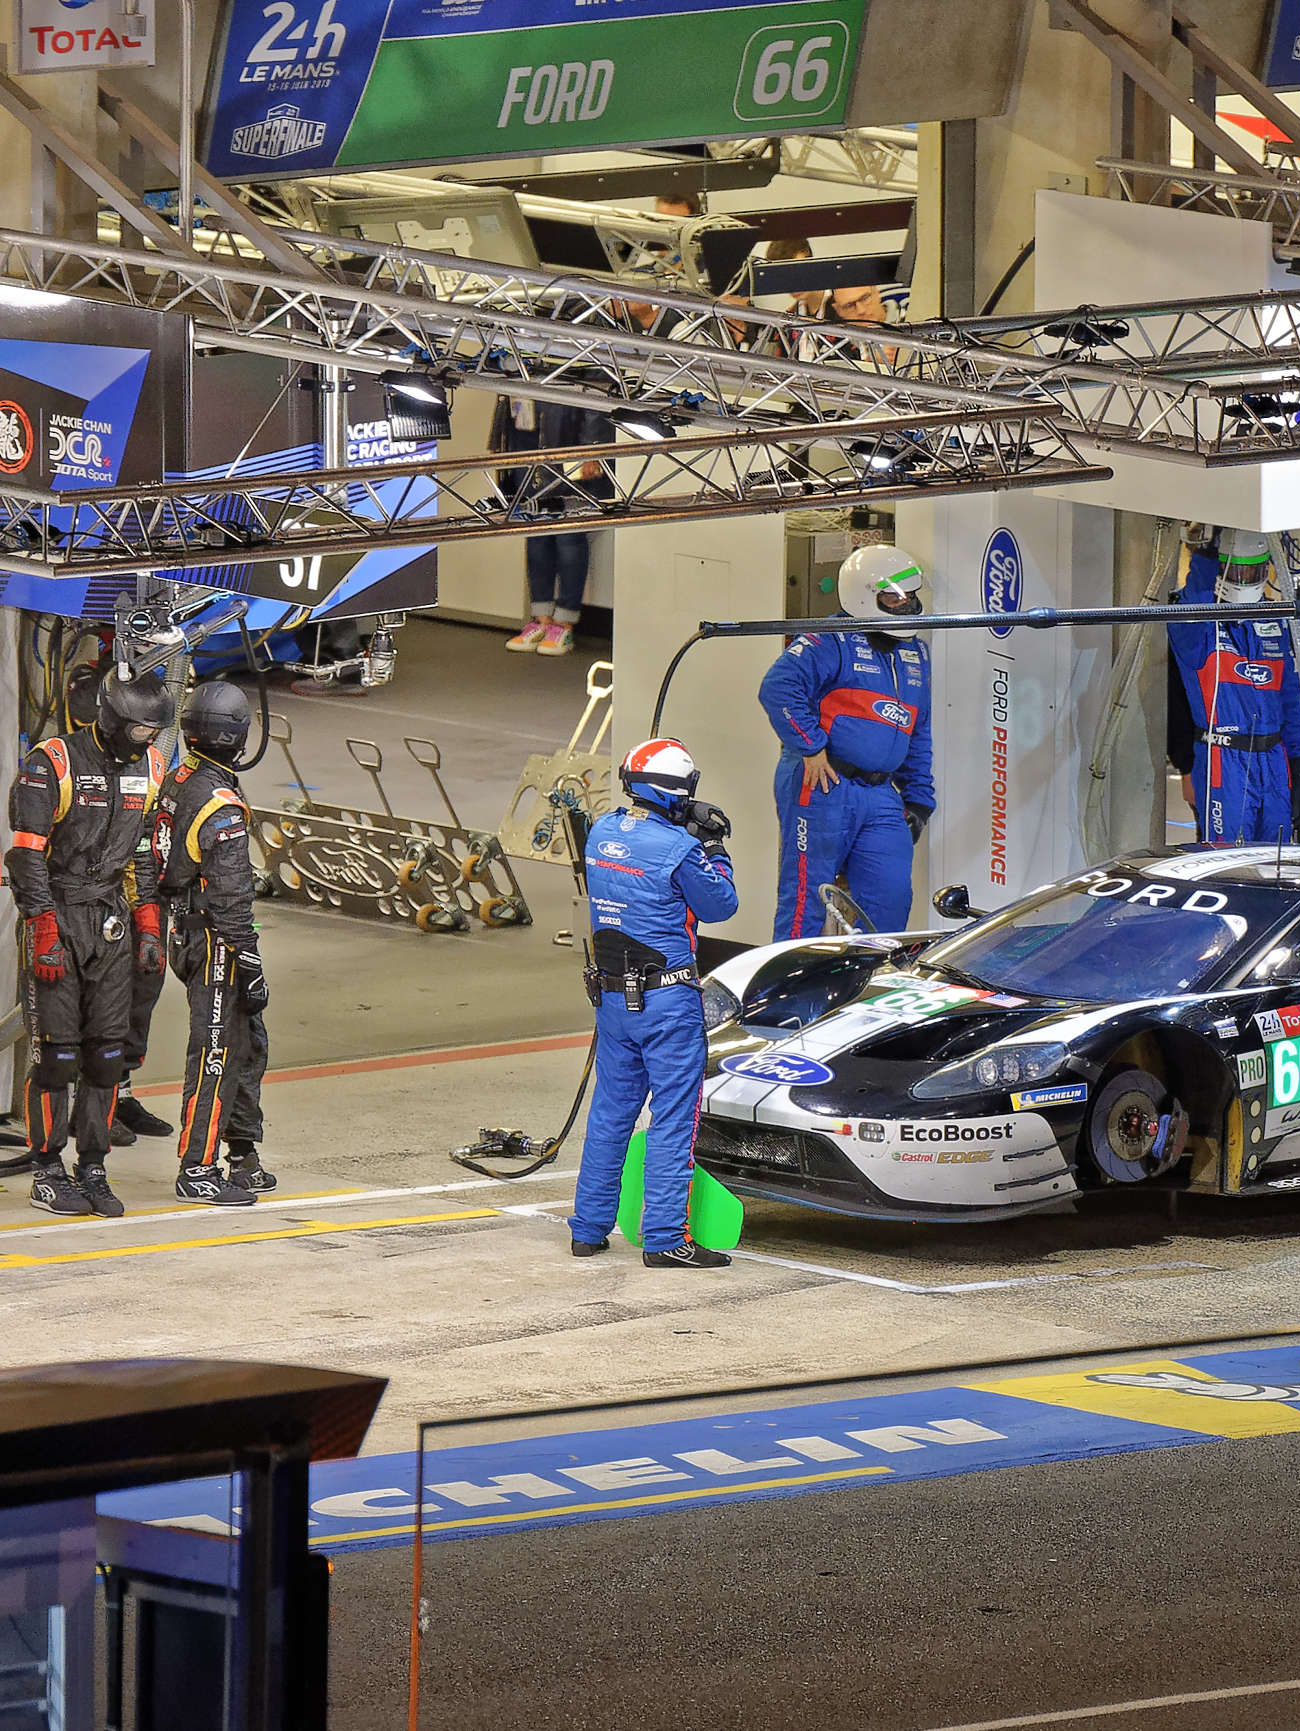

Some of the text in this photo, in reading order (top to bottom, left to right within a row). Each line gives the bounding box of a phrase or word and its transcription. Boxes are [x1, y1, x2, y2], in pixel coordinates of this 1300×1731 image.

[29, 26, 141, 54] TOTAL
[239, 62, 336, 82] LE MANS
[753, 36, 832, 105] 66
[497, 59, 615, 128] FORD
[233, 119, 325, 156] SUPERFINALE
[49, 414, 112, 434] JACKIE CHAN
[347, 420, 389, 440] ACKIE
[49, 463, 113, 482] JOTA Sport
[989, 549, 1017, 614] Ford
[1245, 664, 1267, 681] Frd
[882, 703, 909, 726] Ford
[990, 668, 1008, 886] FORD PERFORMANCE
[1212, 800, 1223, 835] FORD
[797, 816, 807, 852] FORD
[1065, 870, 1229, 914] FORD
[212, 987, 223, 1024] JOTA
[1260, 1013, 1281, 1031] 24h
[735, 1053, 812, 1083] Ford
[1239, 1056, 1264, 1083] PRO
[1035, 1089, 1082, 1103] MICHELIN
[900, 1124, 1013, 1143] EcoBoost
[901, 1149, 998, 1164] Castrol EDGE
[310, 1418, 1008, 1528] CHELIN
